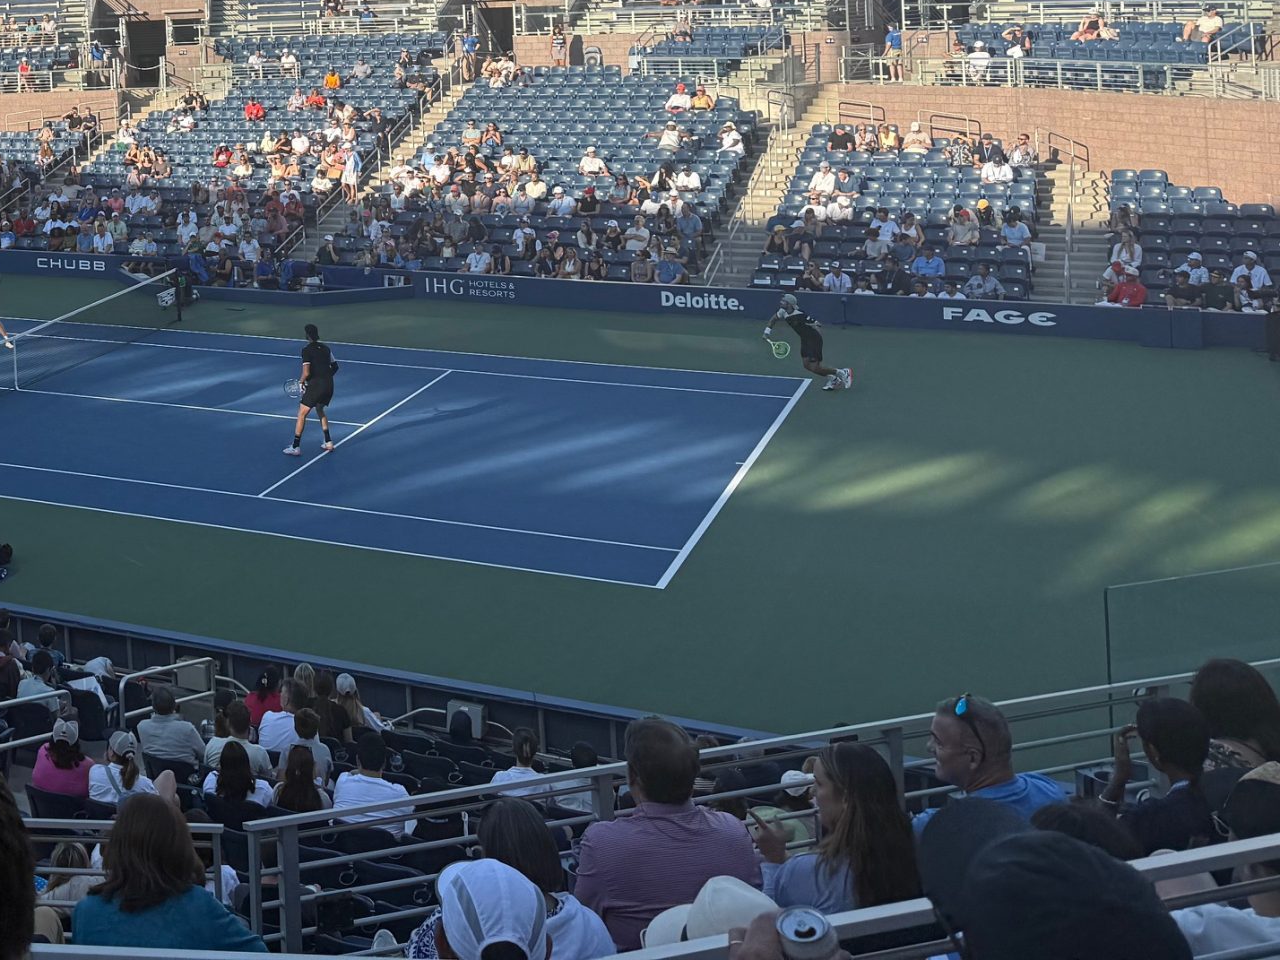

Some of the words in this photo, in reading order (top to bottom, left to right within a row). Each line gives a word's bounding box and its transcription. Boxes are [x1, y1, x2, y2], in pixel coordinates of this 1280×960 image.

[37, 258, 106, 271] CHUBB
[425, 277, 464, 295] IHG
[469, 280, 507, 289] HOTELS
[469, 288, 516, 299] RESORTS
[661, 290, 745, 311] Deloitte.
[942, 306, 1057, 327] FAGE
